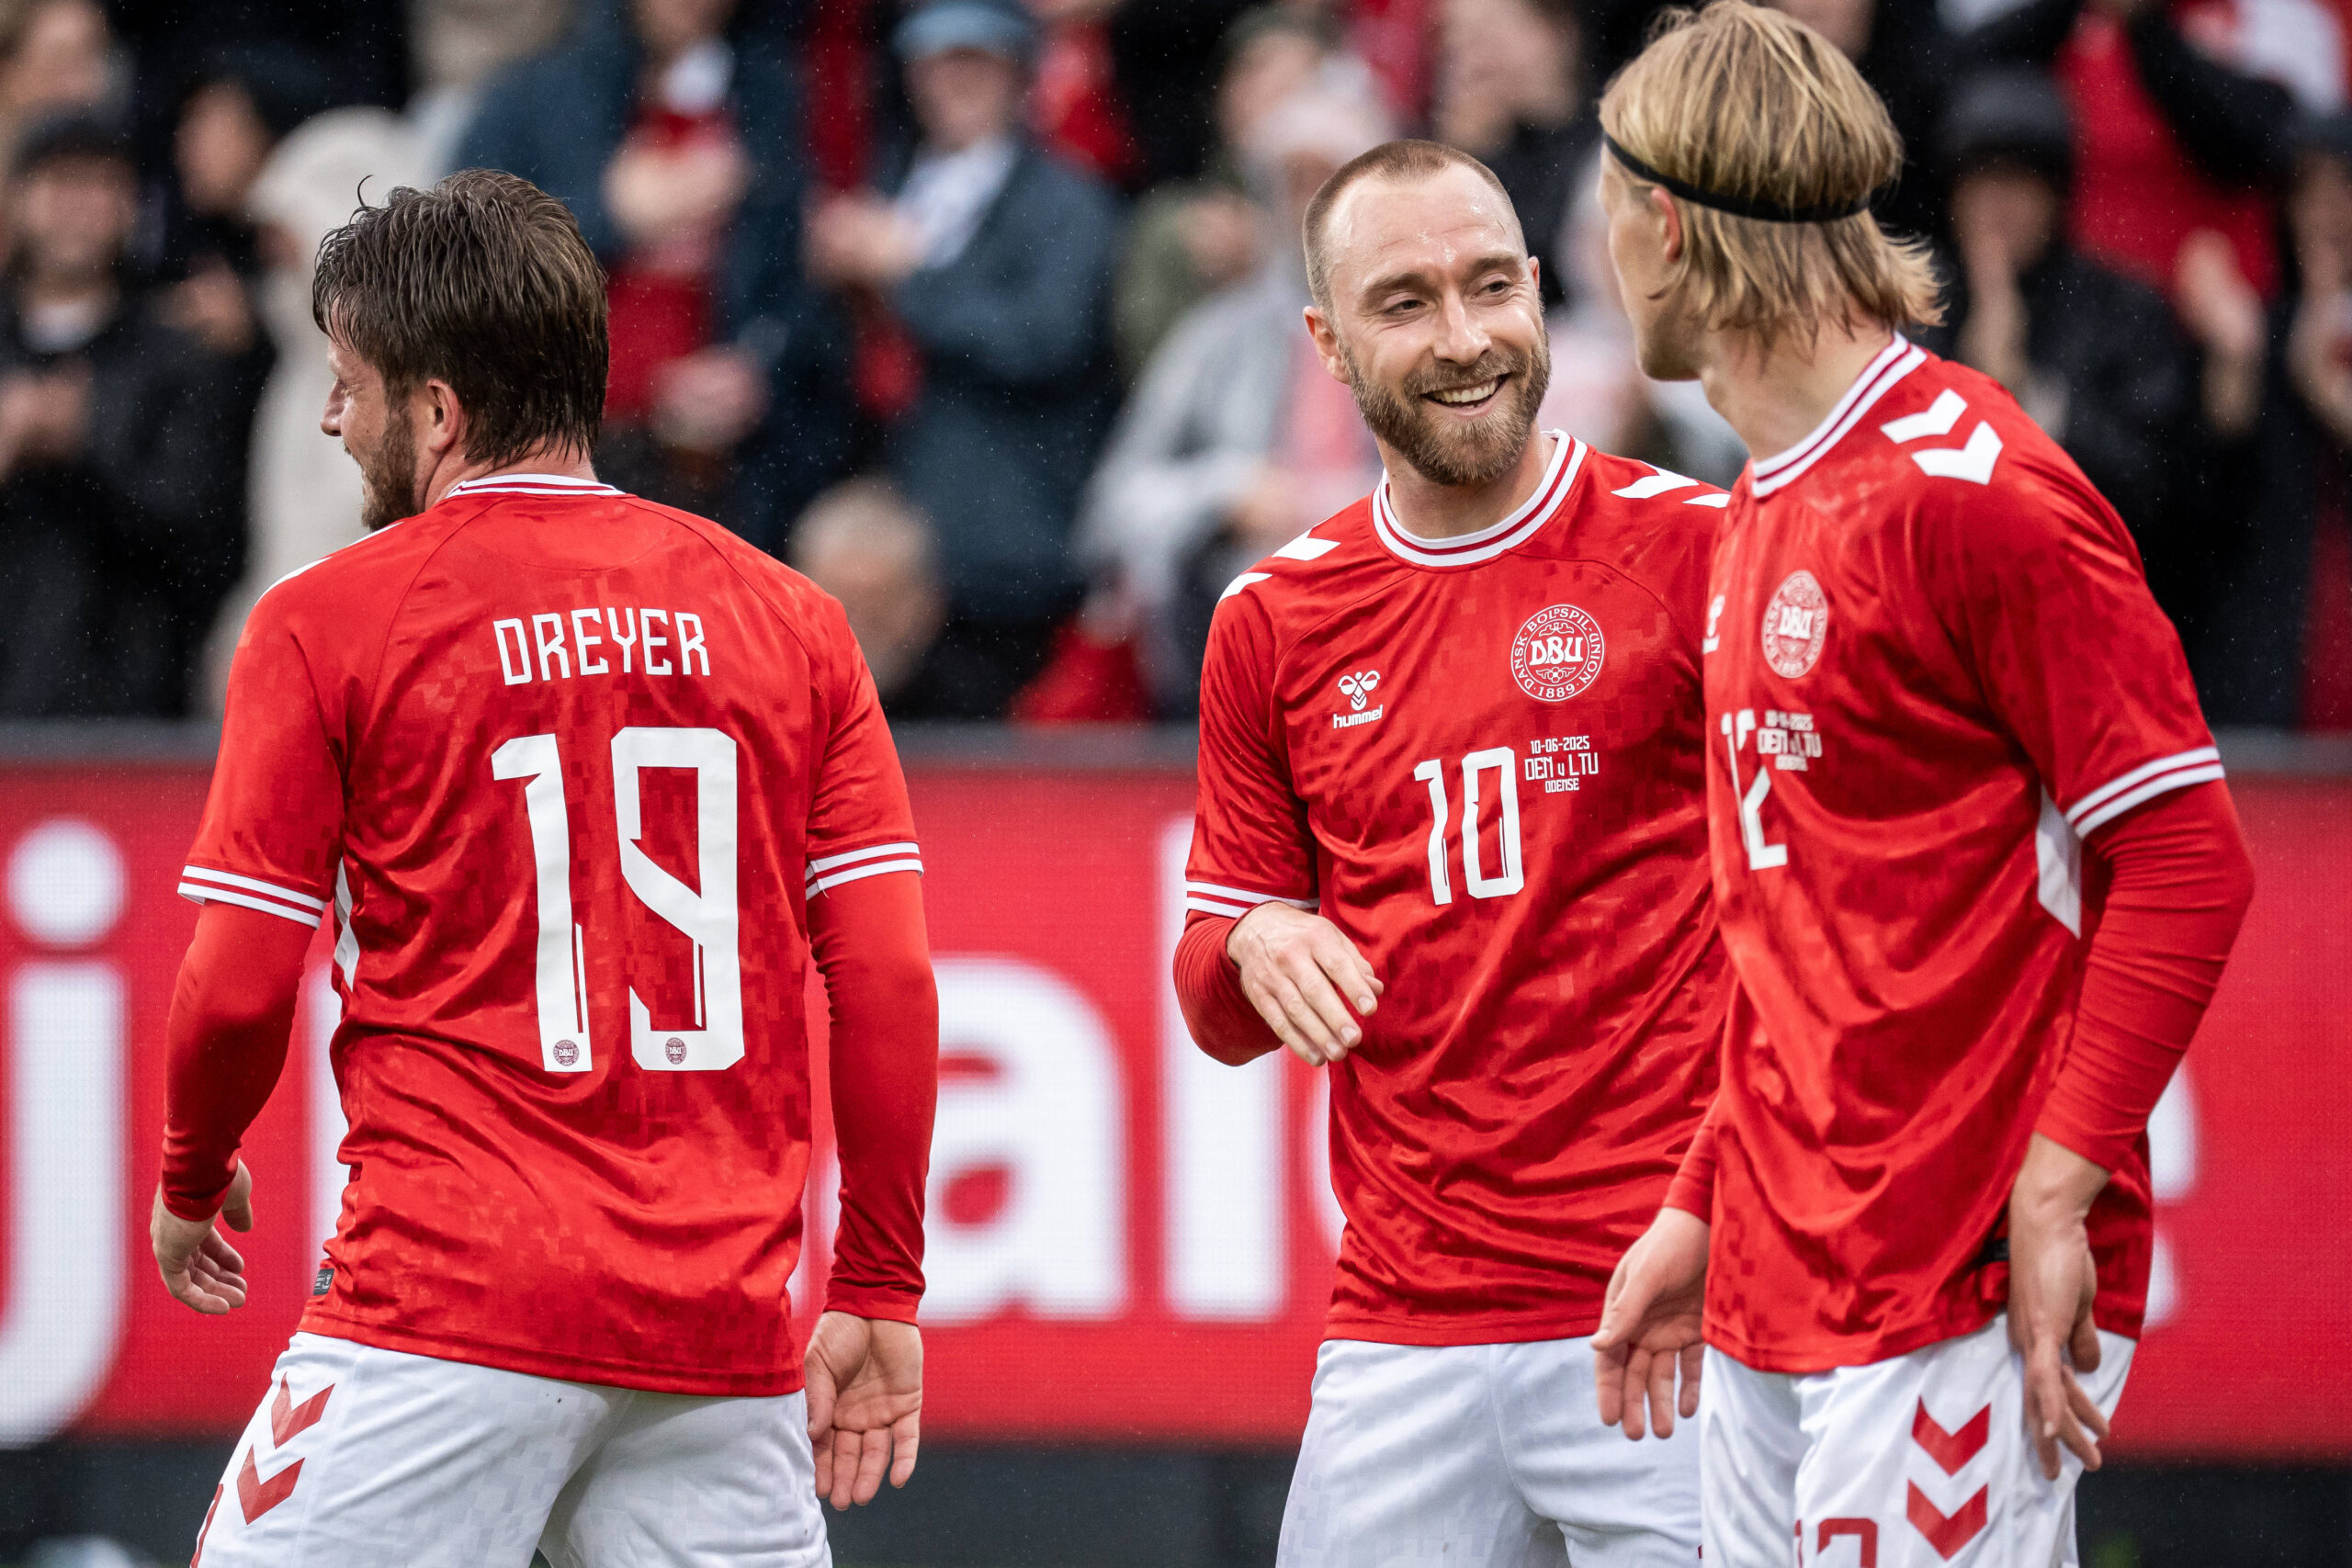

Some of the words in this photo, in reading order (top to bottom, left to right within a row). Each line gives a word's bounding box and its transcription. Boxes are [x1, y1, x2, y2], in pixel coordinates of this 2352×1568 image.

[492, 607, 711, 685] DREYER
[1529, 636, 1584, 666] DBU
[1514, 636, 1534, 690] DANSK
[1538, 683, 1576, 698] 1889
[1333, 704, 1384, 728] hummel
[1530, 735, 1590, 754] 10-06-2025
[1524, 756, 1554, 781] DEN
[1568, 751, 1599, 775] LTU
[1544, 777, 1580, 794] ODENSE
[1414, 746, 1525, 905] 10
[491, 727, 746, 1072] 19
